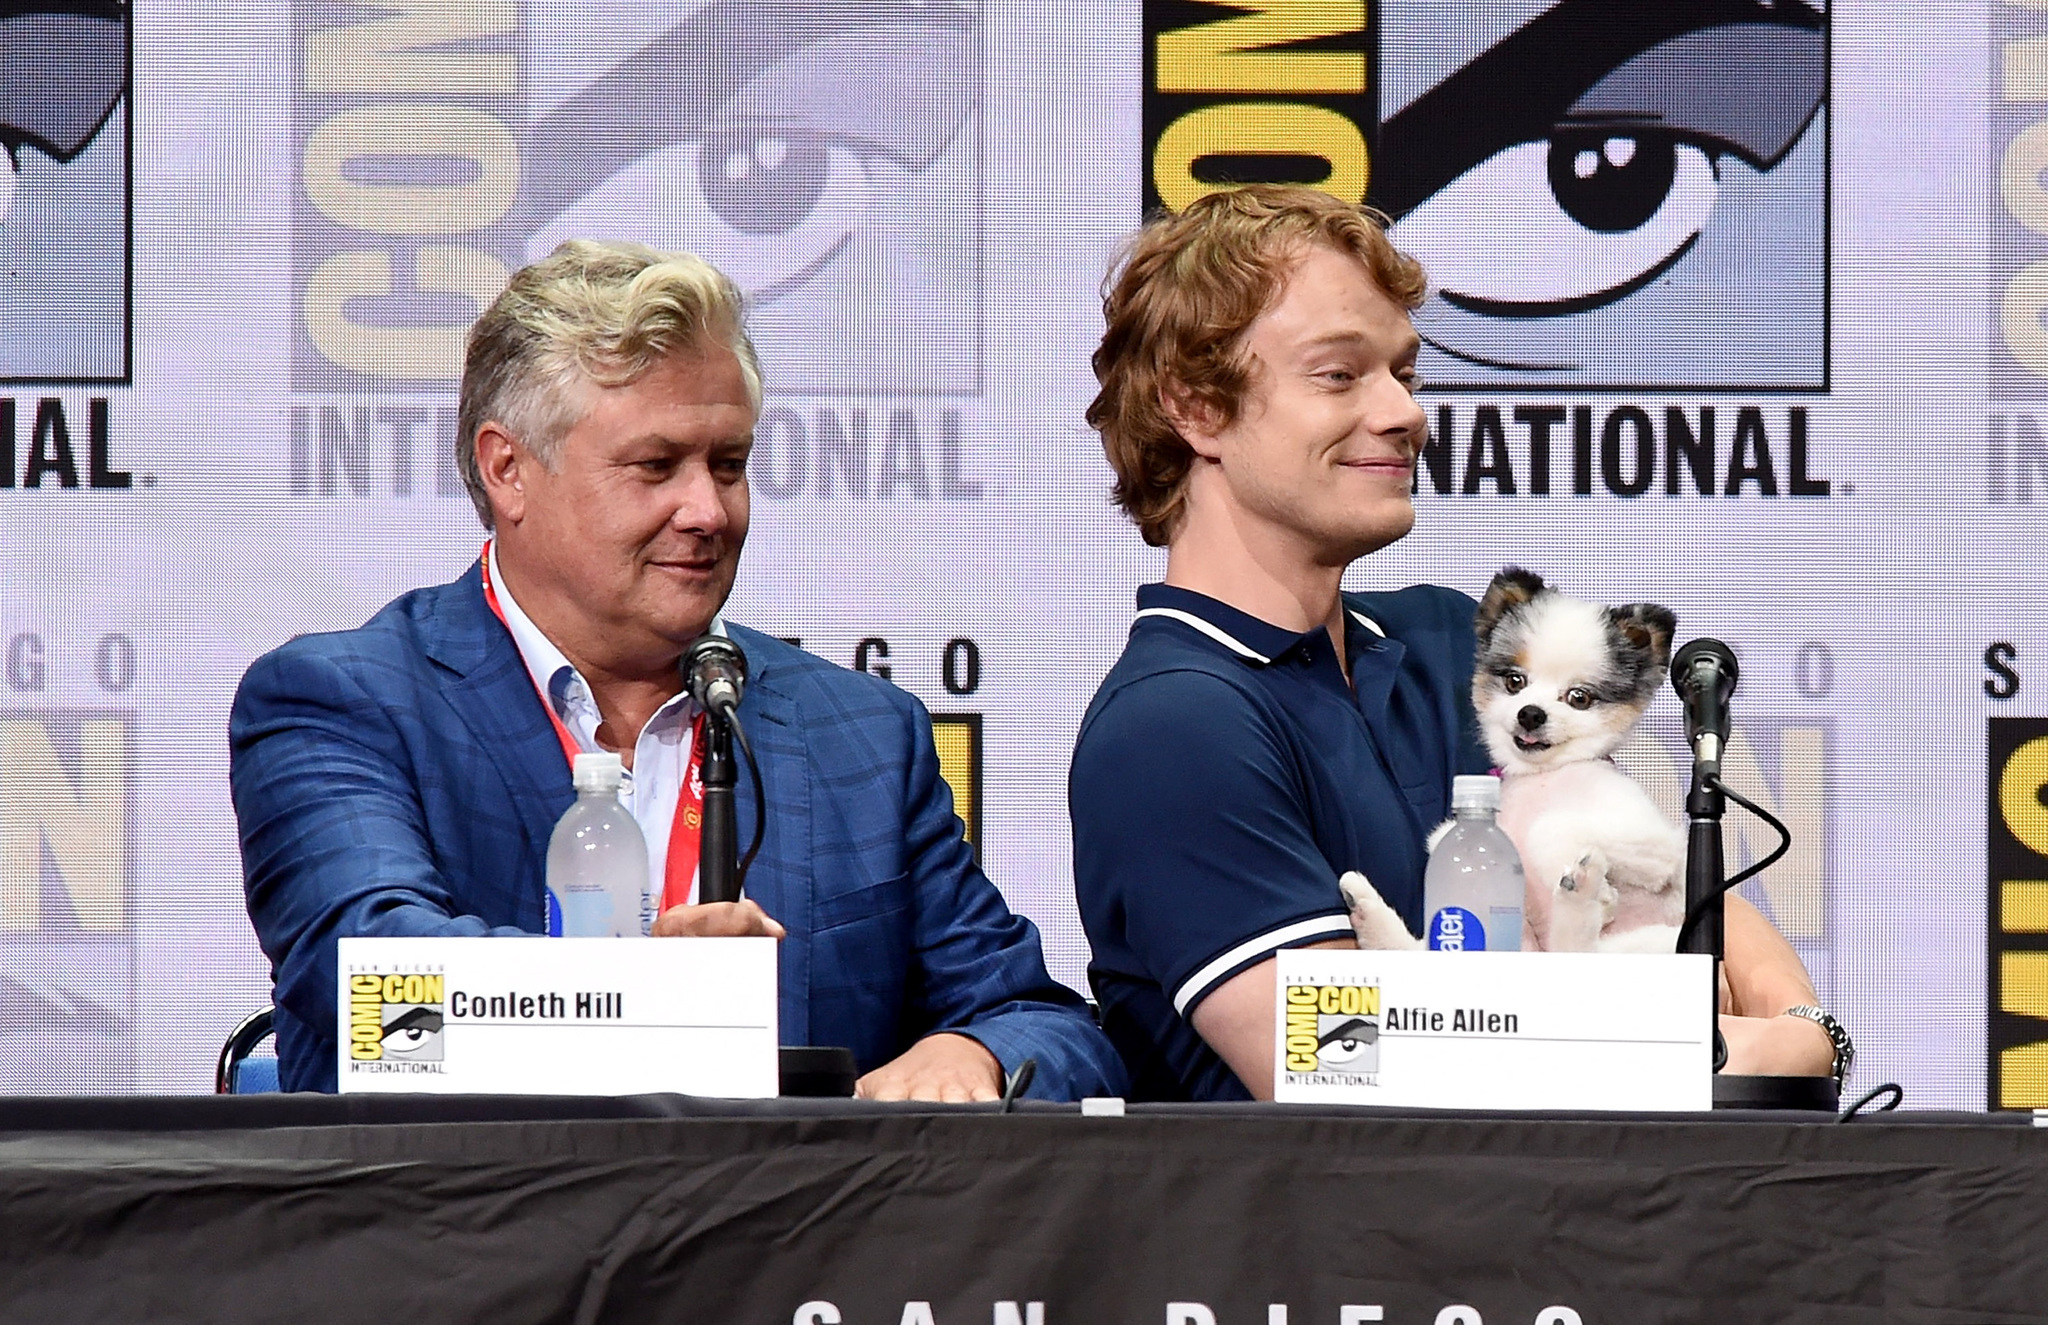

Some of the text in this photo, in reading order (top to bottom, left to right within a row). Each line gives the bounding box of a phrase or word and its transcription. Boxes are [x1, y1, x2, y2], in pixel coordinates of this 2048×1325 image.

[382, 974, 444, 1004] CON
[1319, 985, 1379, 1016] CON
[351, 975, 383, 1060] COMIC
[451, 990, 623, 1019] Conleth Hill
[1286, 986, 1319, 1072] COMIC
[1386, 1007, 1518, 1033] Alfie Allen
